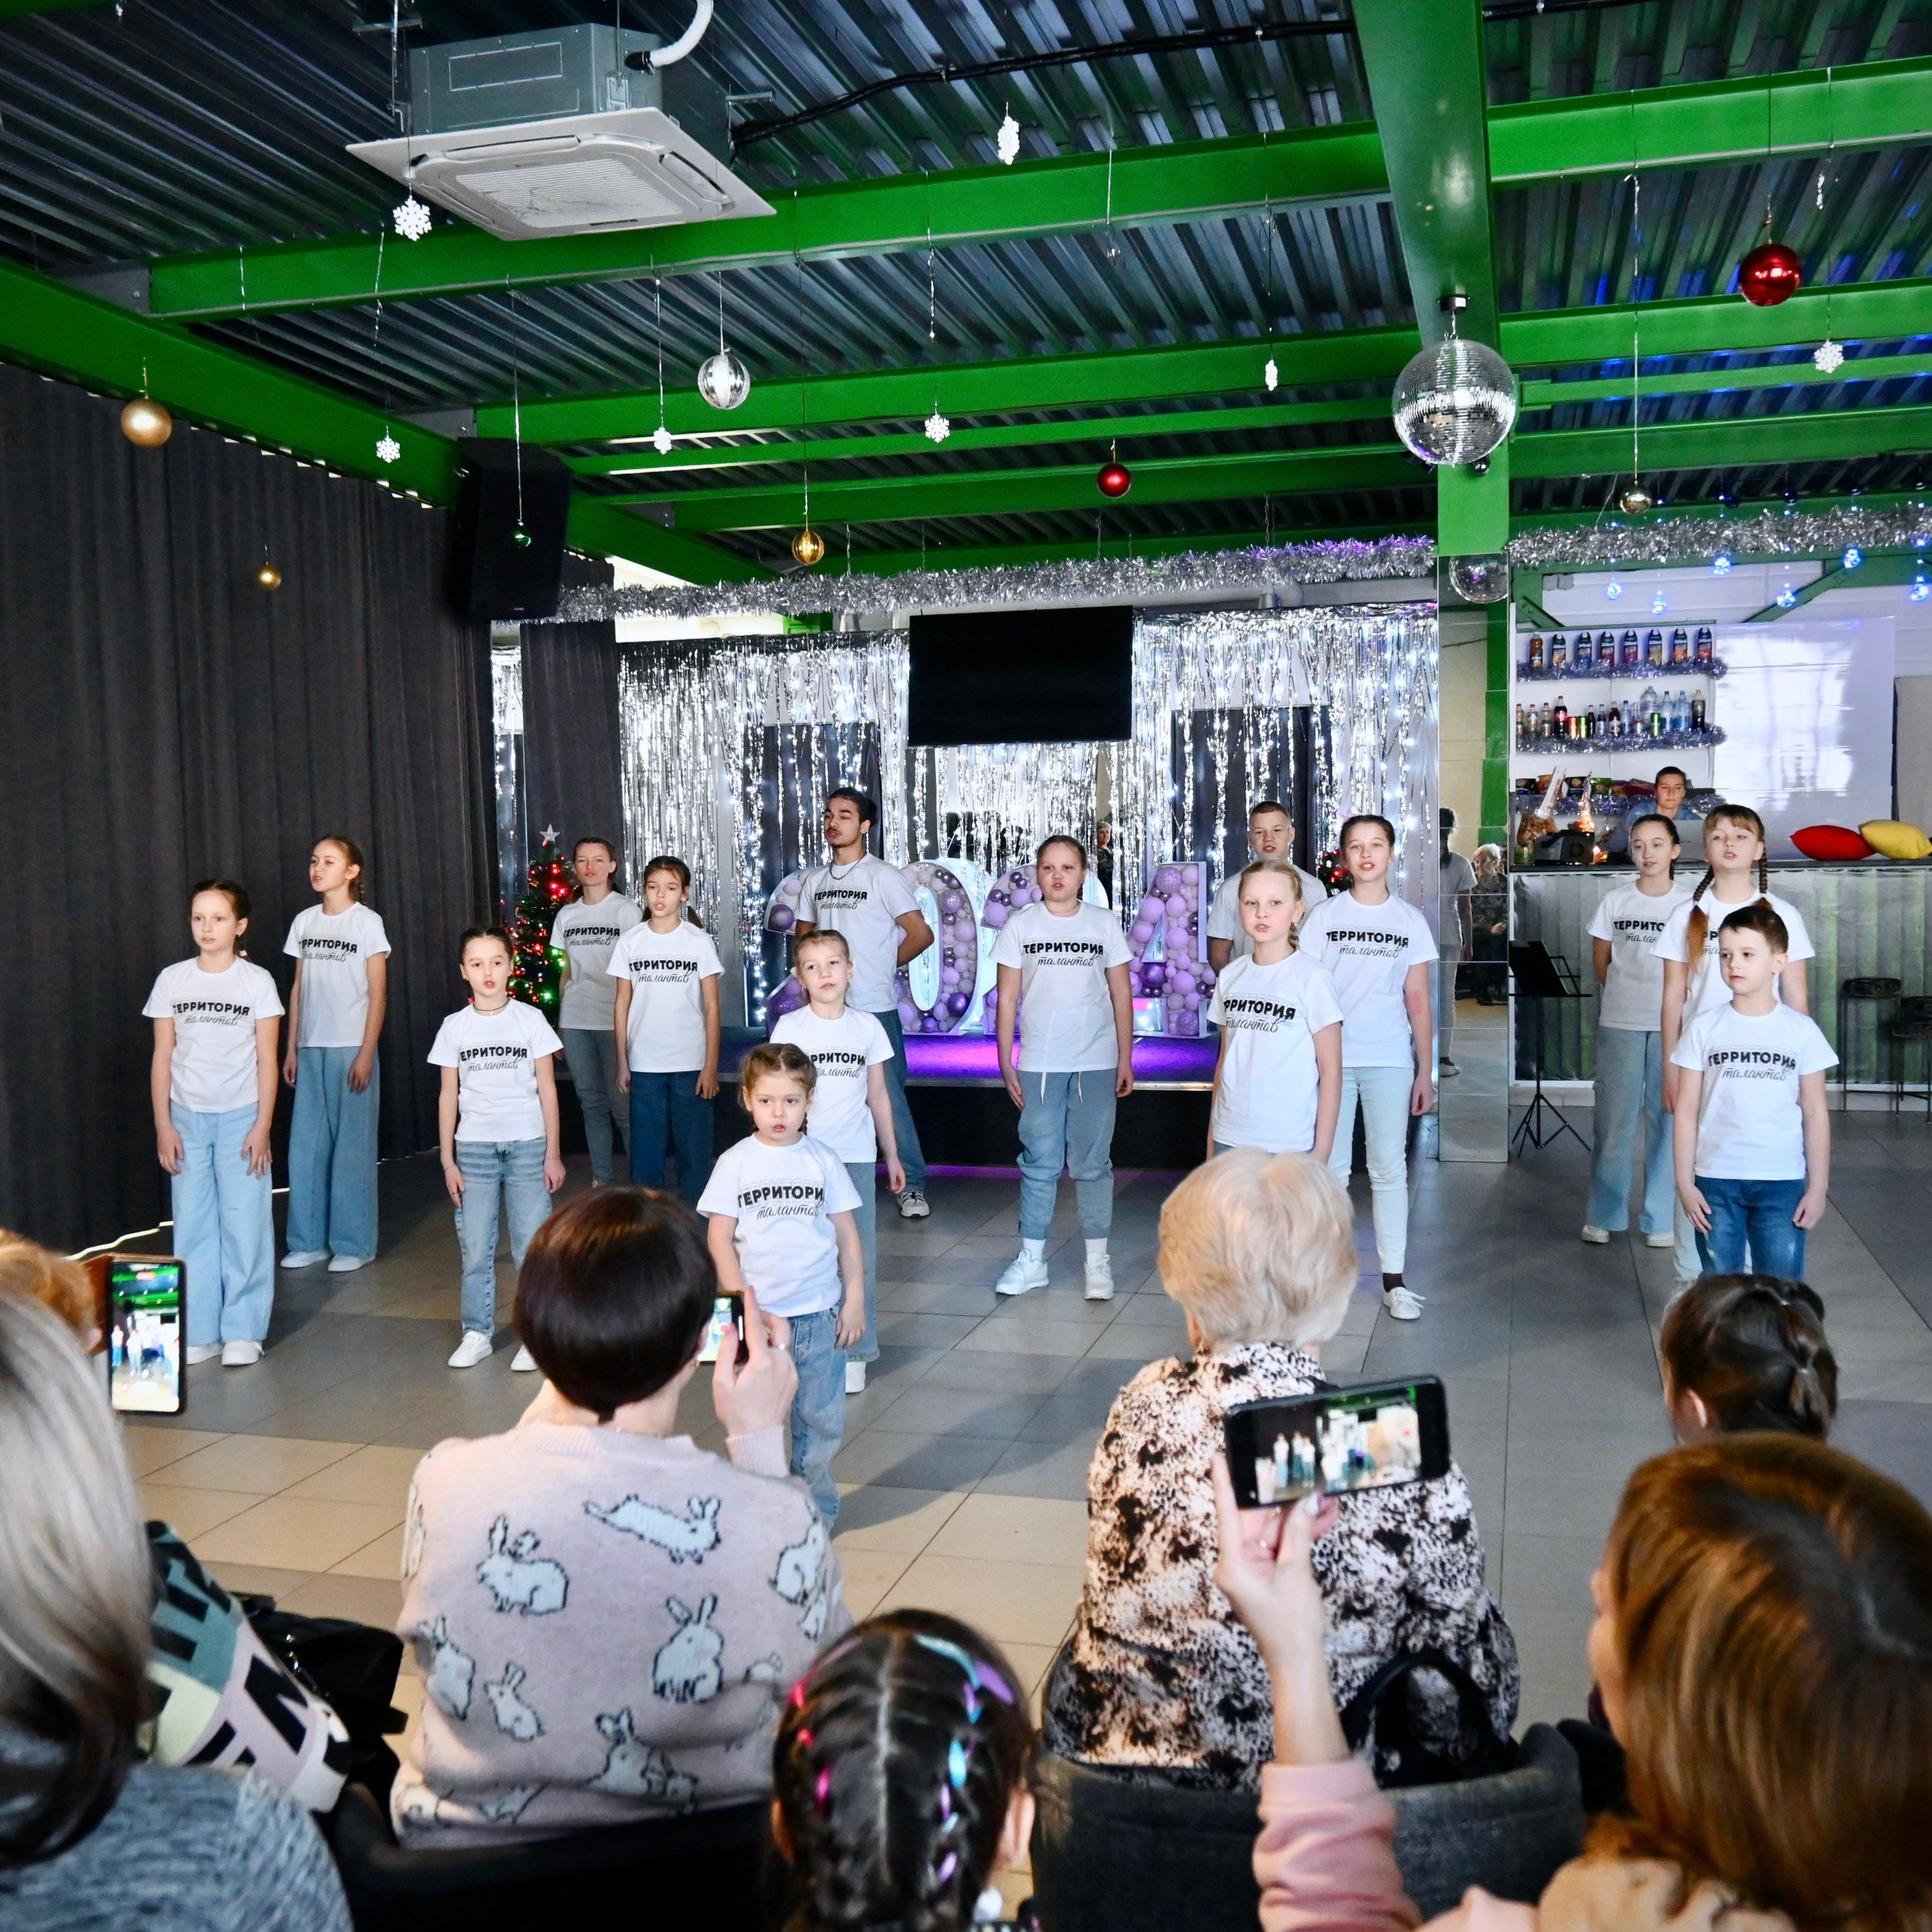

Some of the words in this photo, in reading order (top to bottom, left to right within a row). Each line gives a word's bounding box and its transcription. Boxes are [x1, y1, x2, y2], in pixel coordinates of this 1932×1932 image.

[1613, 920, 1665, 932] ТЕРРИТО
[1326, 931, 1409, 949] ТЕРРИТОРИЯ
[1023, 943, 1103, 955] ТЕРРИТОРИЯ
[460, 1046, 528, 1062] ЕРРИТОРИЯ
[738, 1186, 825, 1208] ТЕРРИТОРИ
